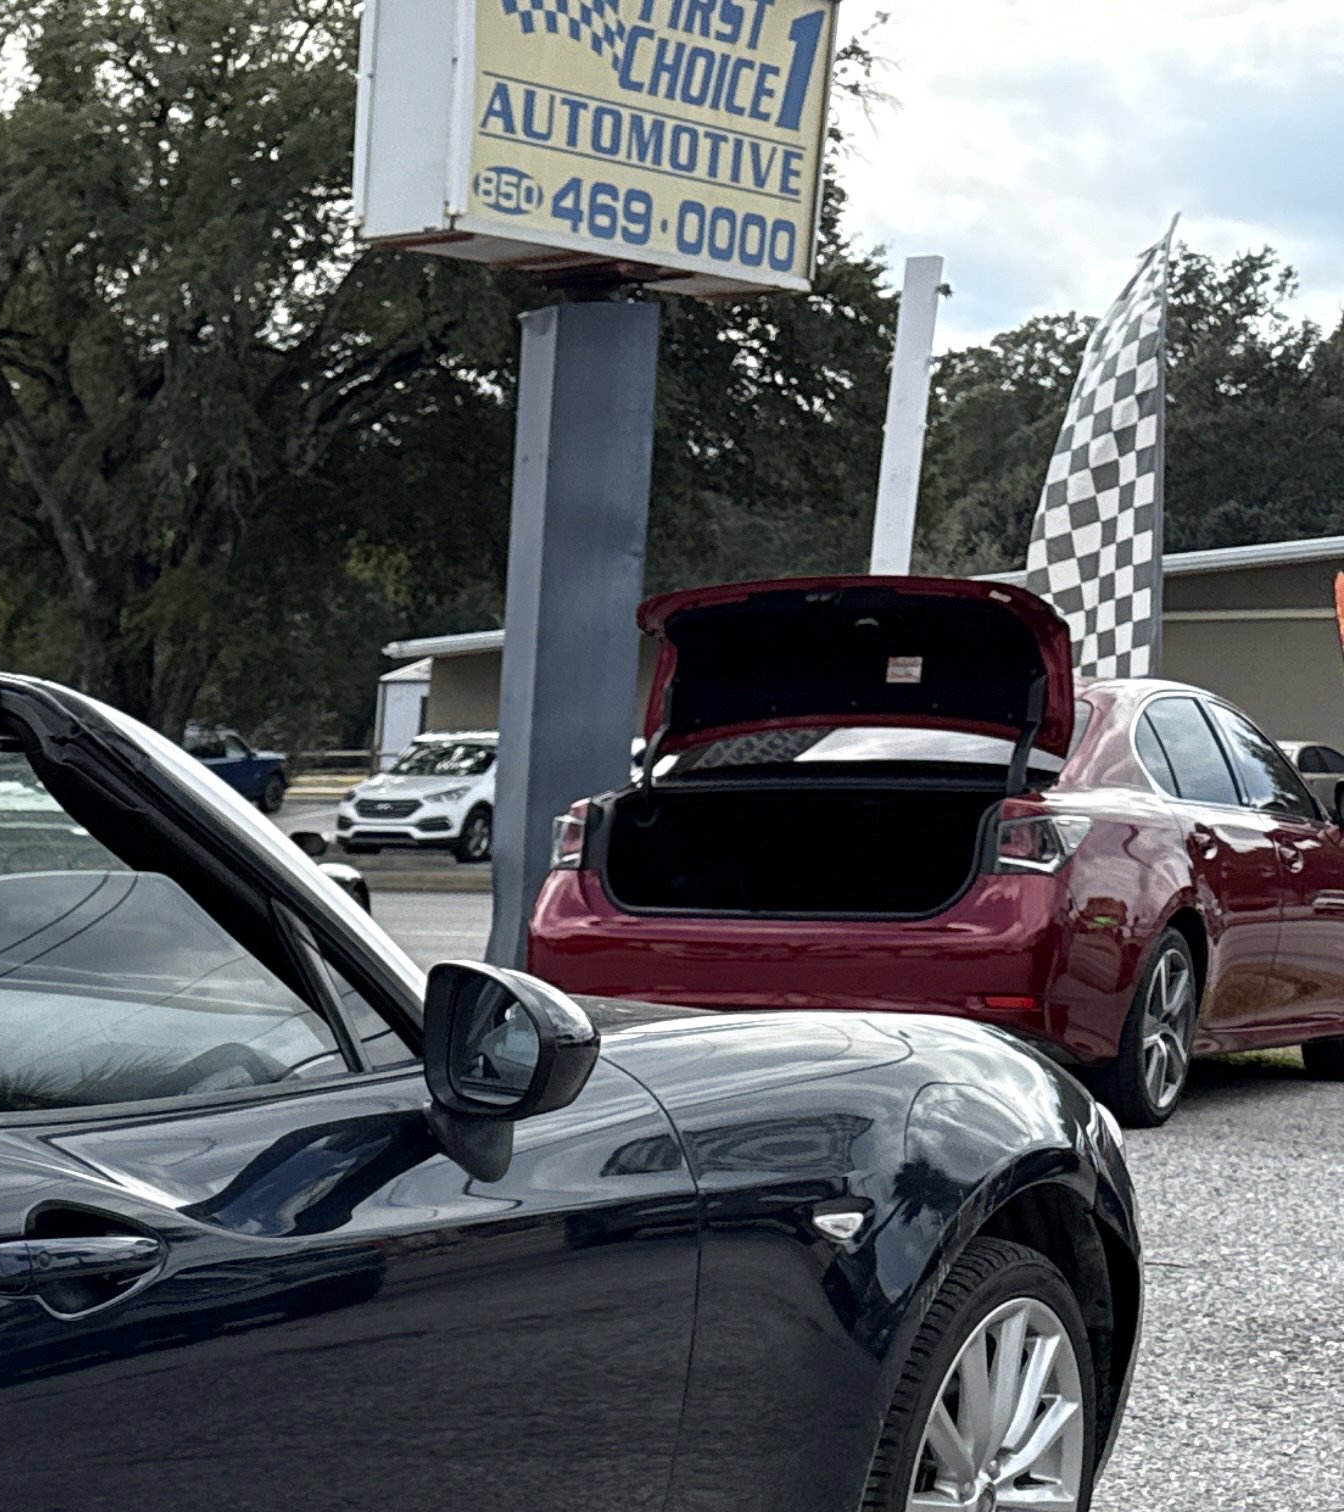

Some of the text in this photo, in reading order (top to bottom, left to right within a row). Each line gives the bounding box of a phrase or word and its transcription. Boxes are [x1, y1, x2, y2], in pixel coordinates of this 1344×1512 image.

[618, 10, 826, 131] CHOICE 1
[475, 168, 543, 213] 850
[480, 83, 805, 196] AUTOMOTIVE
